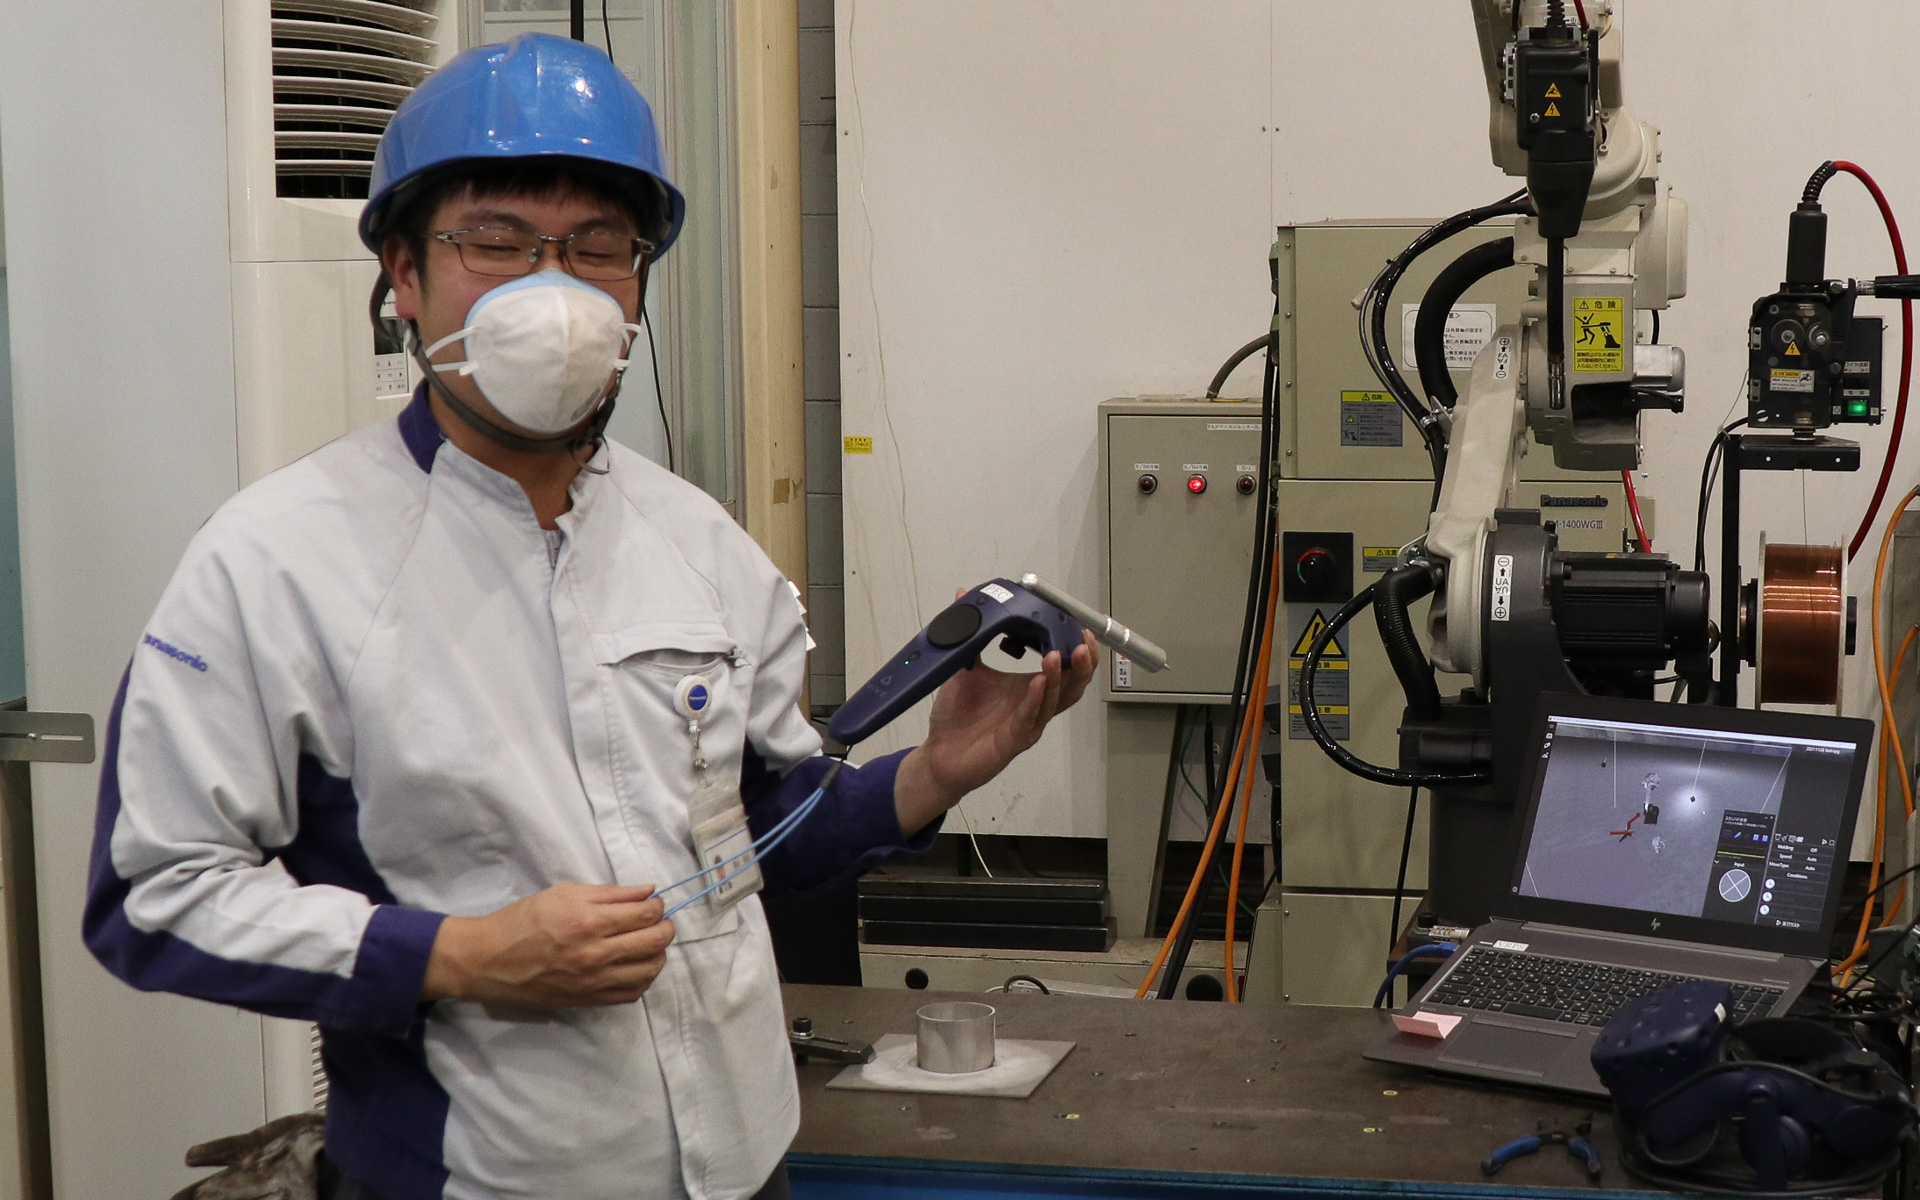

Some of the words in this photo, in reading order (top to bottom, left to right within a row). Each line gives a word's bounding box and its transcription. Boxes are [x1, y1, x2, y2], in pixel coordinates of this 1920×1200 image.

[1594, 300, 1616, 309] 危険
[1541, 494, 1608, 507] Panasonic
[1495, 578, 1509, 586] UA
[986, 584, 1009, 599] PEC
[1498, 941, 1526, 950] VRPS
